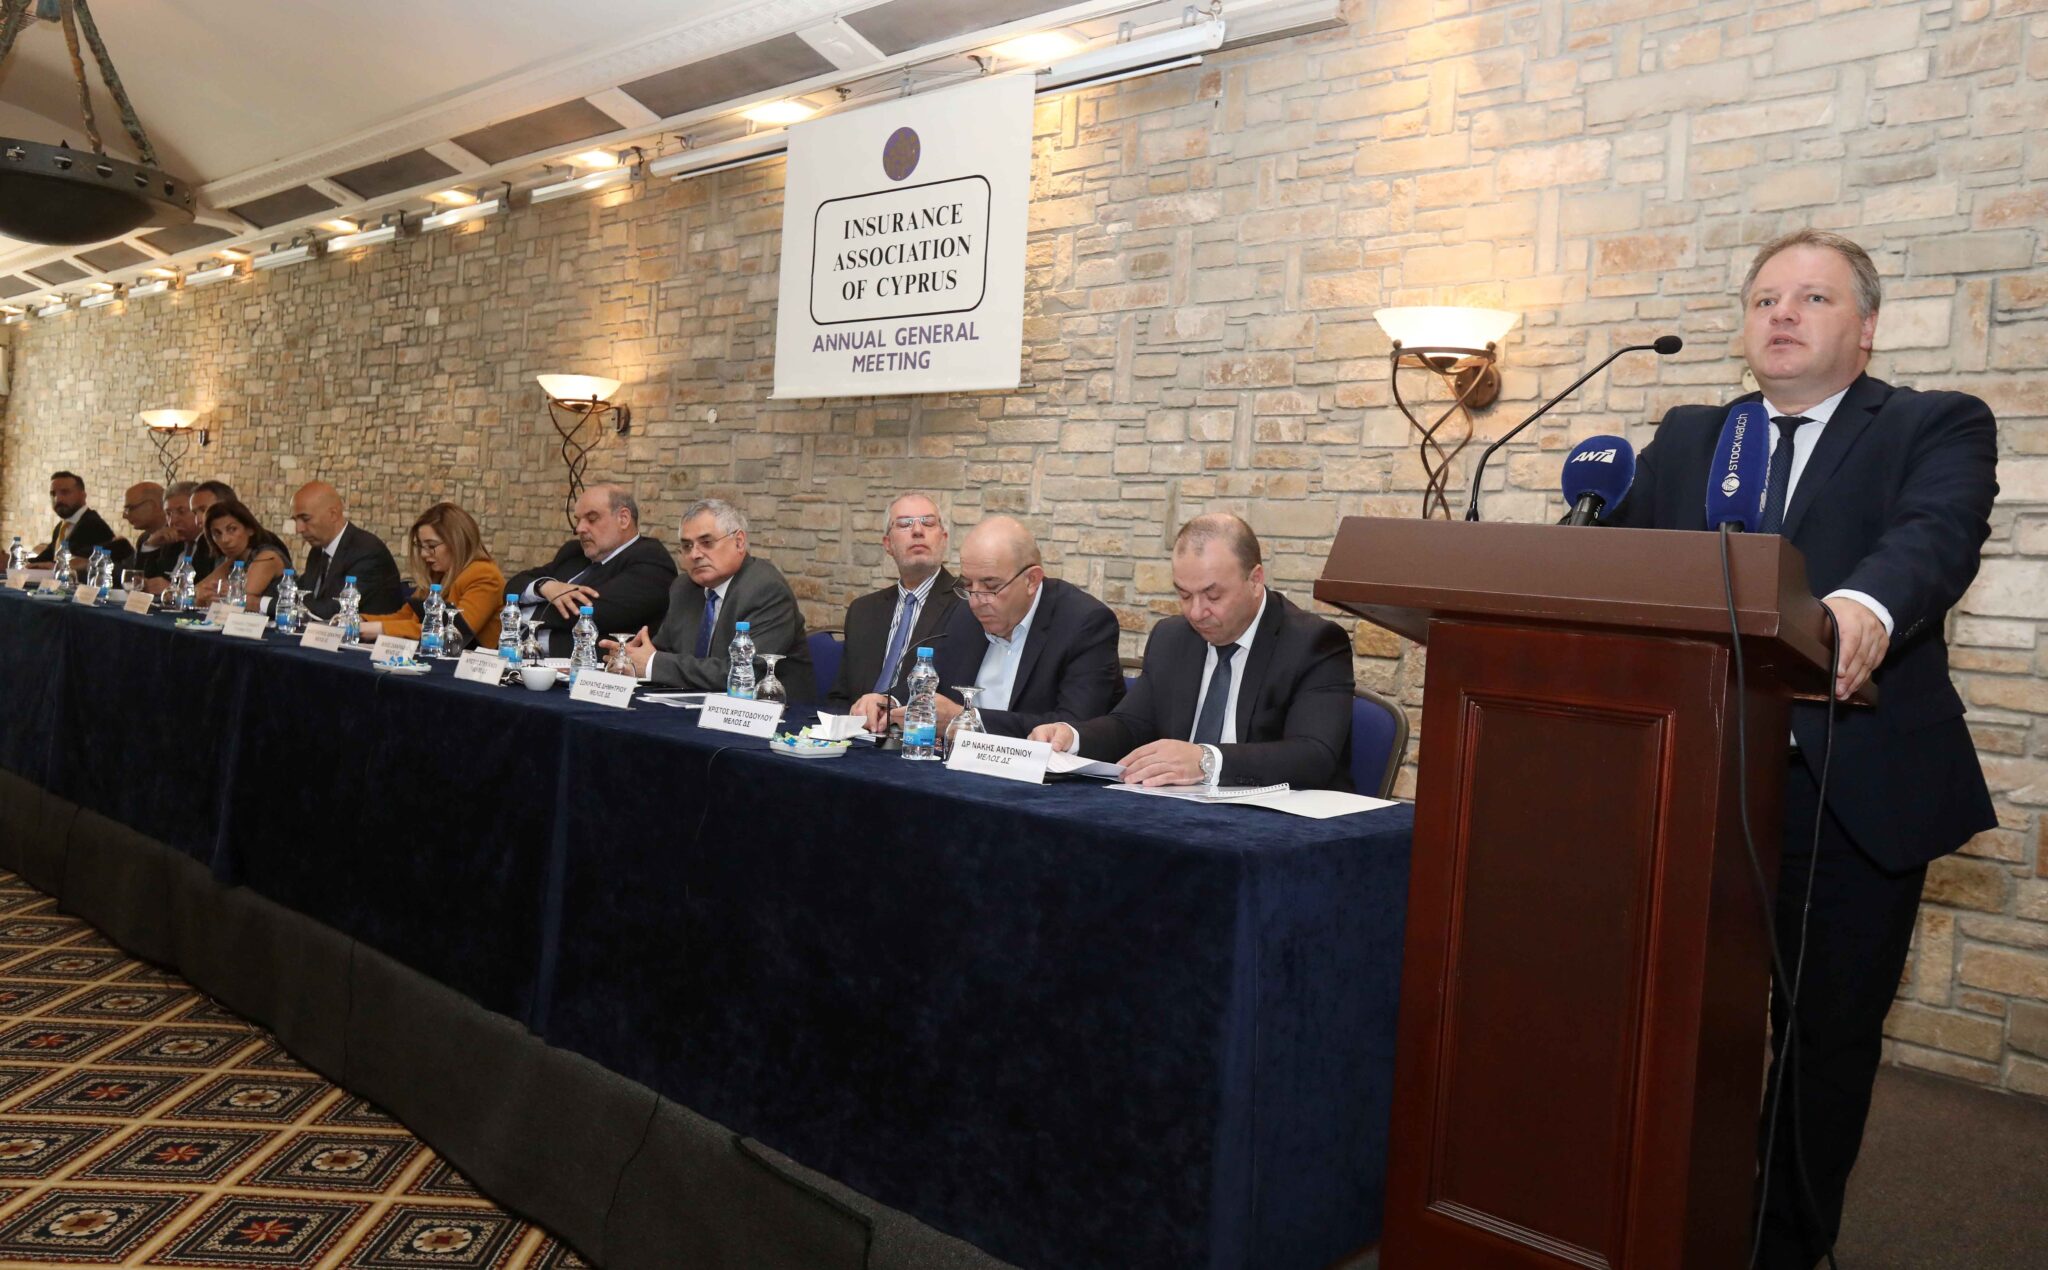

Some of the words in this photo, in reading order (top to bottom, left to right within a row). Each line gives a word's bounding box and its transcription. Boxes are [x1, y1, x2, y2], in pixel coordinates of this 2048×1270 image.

[843, 203, 963, 240] INSURANCE
[833, 234, 972, 272] ASSOCIATION
[842, 279, 867, 301] OF
[876, 269, 957, 298] CYPRUS
[812, 329, 886, 353] ANNUAL
[895, 321, 979, 347] GENERAL
[852, 350, 931, 373] MEETING
[708, 705, 730, 715] ΧΡΙΣΤΟΣ
[731, 709, 774, 722] ΧΡΙΣΤΟΔΟΥΛΟΥ
[723, 717, 743, 726] ΜΕΛΟΣ
[961, 740, 971, 748] ΔΡ
[972, 742, 996, 753] ΝΑΚΗΣ
[995, 746, 1032, 759] ΑΝΤΩΝΙΟΥ
[976, 753, 1001, 763] ΜΕΛΟΣ
[1001, 757, 1012, 765] ΔΣ
